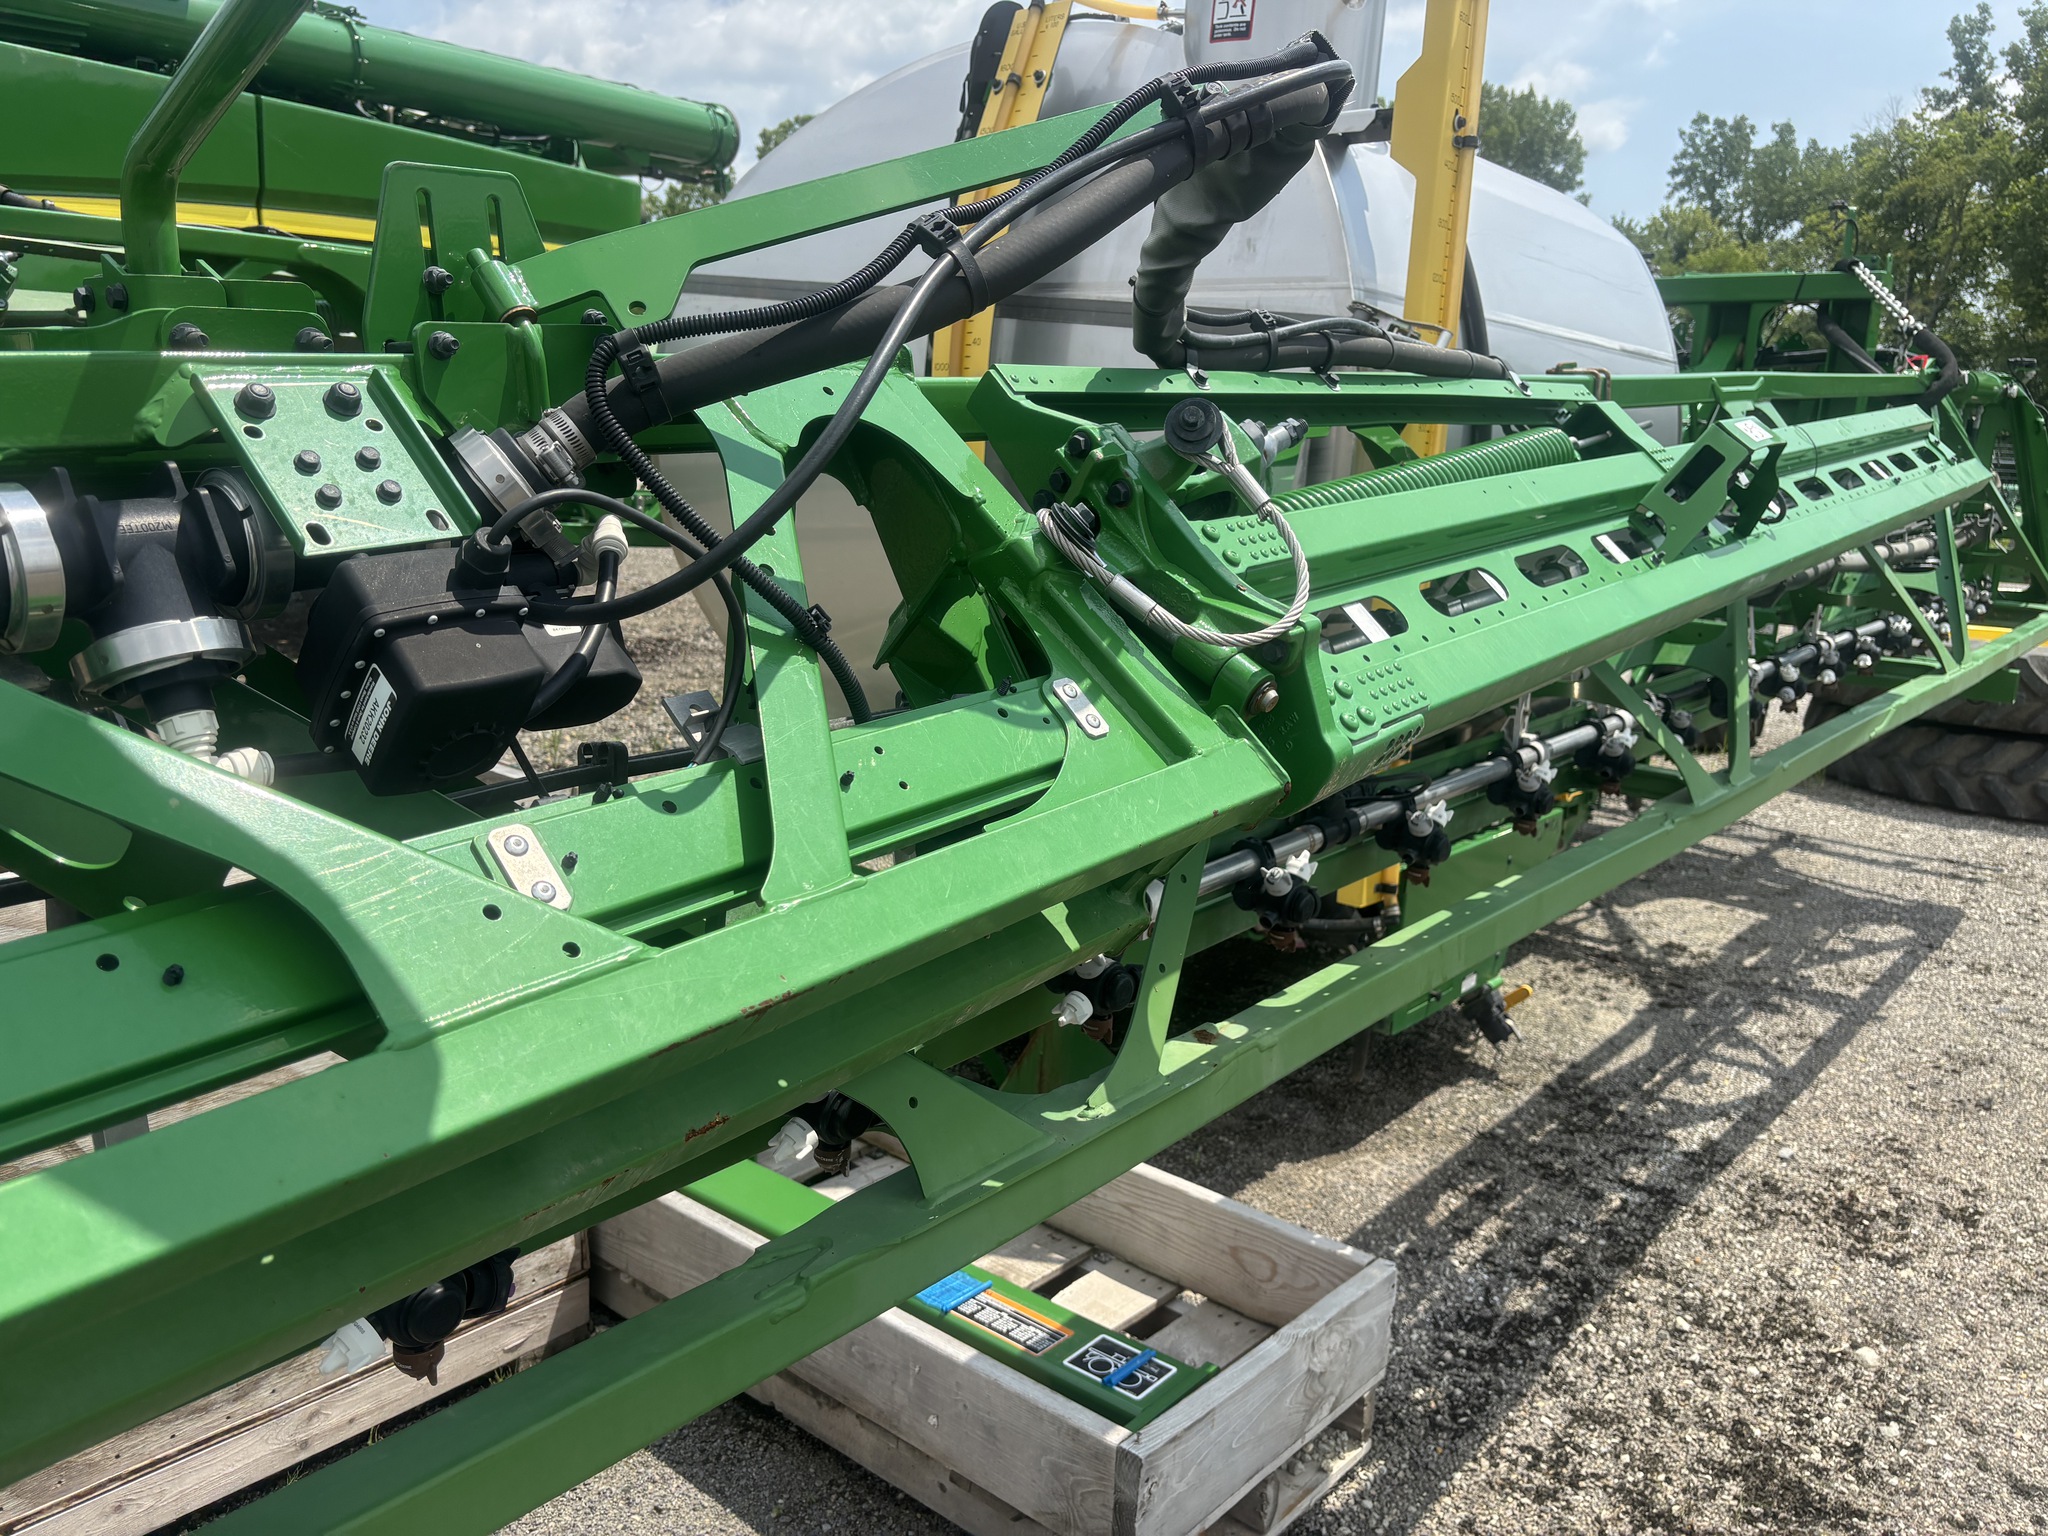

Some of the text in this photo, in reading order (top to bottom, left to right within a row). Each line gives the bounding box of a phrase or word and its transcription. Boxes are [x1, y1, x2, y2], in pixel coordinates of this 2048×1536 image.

[972, 337, 982, 346] 40
[119, 521, 174, 534] M200TEE
[365, 701, 392, 766] JOHN DEERE
